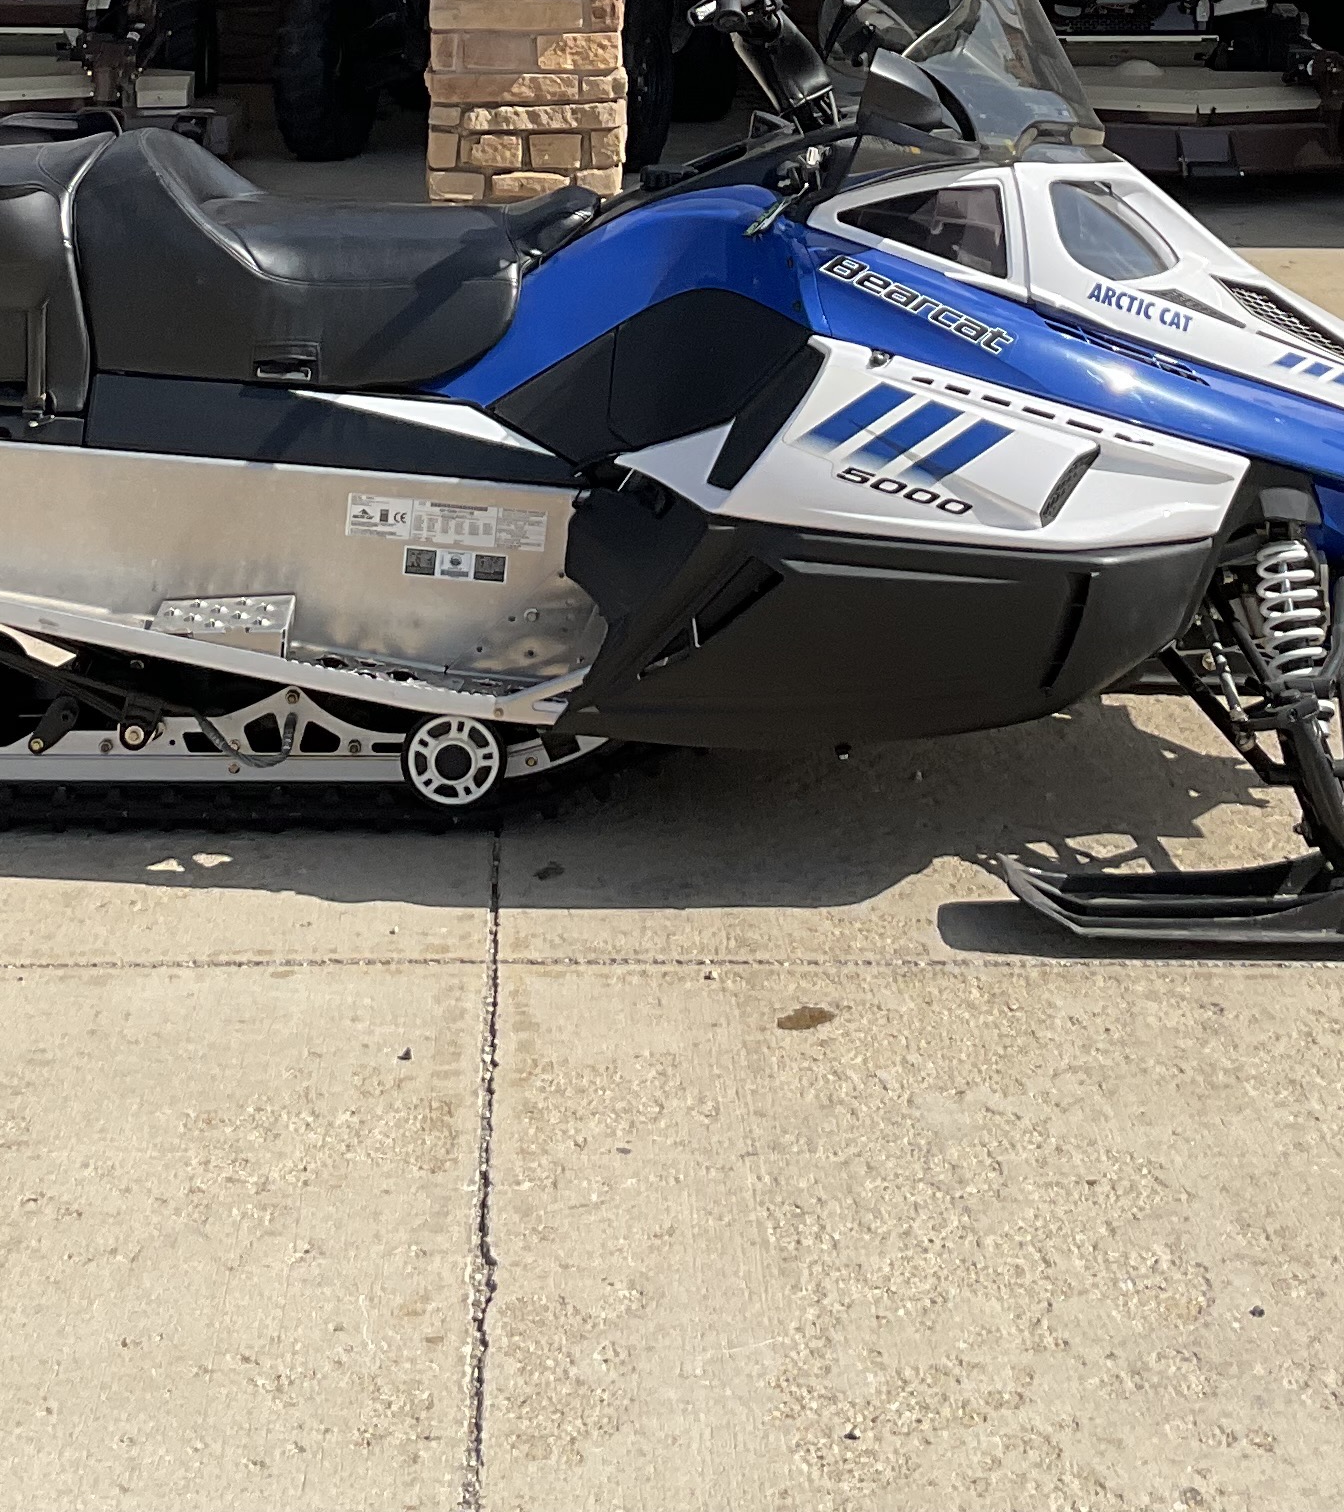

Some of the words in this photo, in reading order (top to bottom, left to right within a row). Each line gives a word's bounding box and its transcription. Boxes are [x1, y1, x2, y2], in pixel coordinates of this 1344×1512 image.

[818, 254, 1014, 356] Bearcat
[1086, 281, 1156, 321] ARCTIC
[1158, 306, 1194, 332] CAT
[835, 466, 974, 516] 5000
